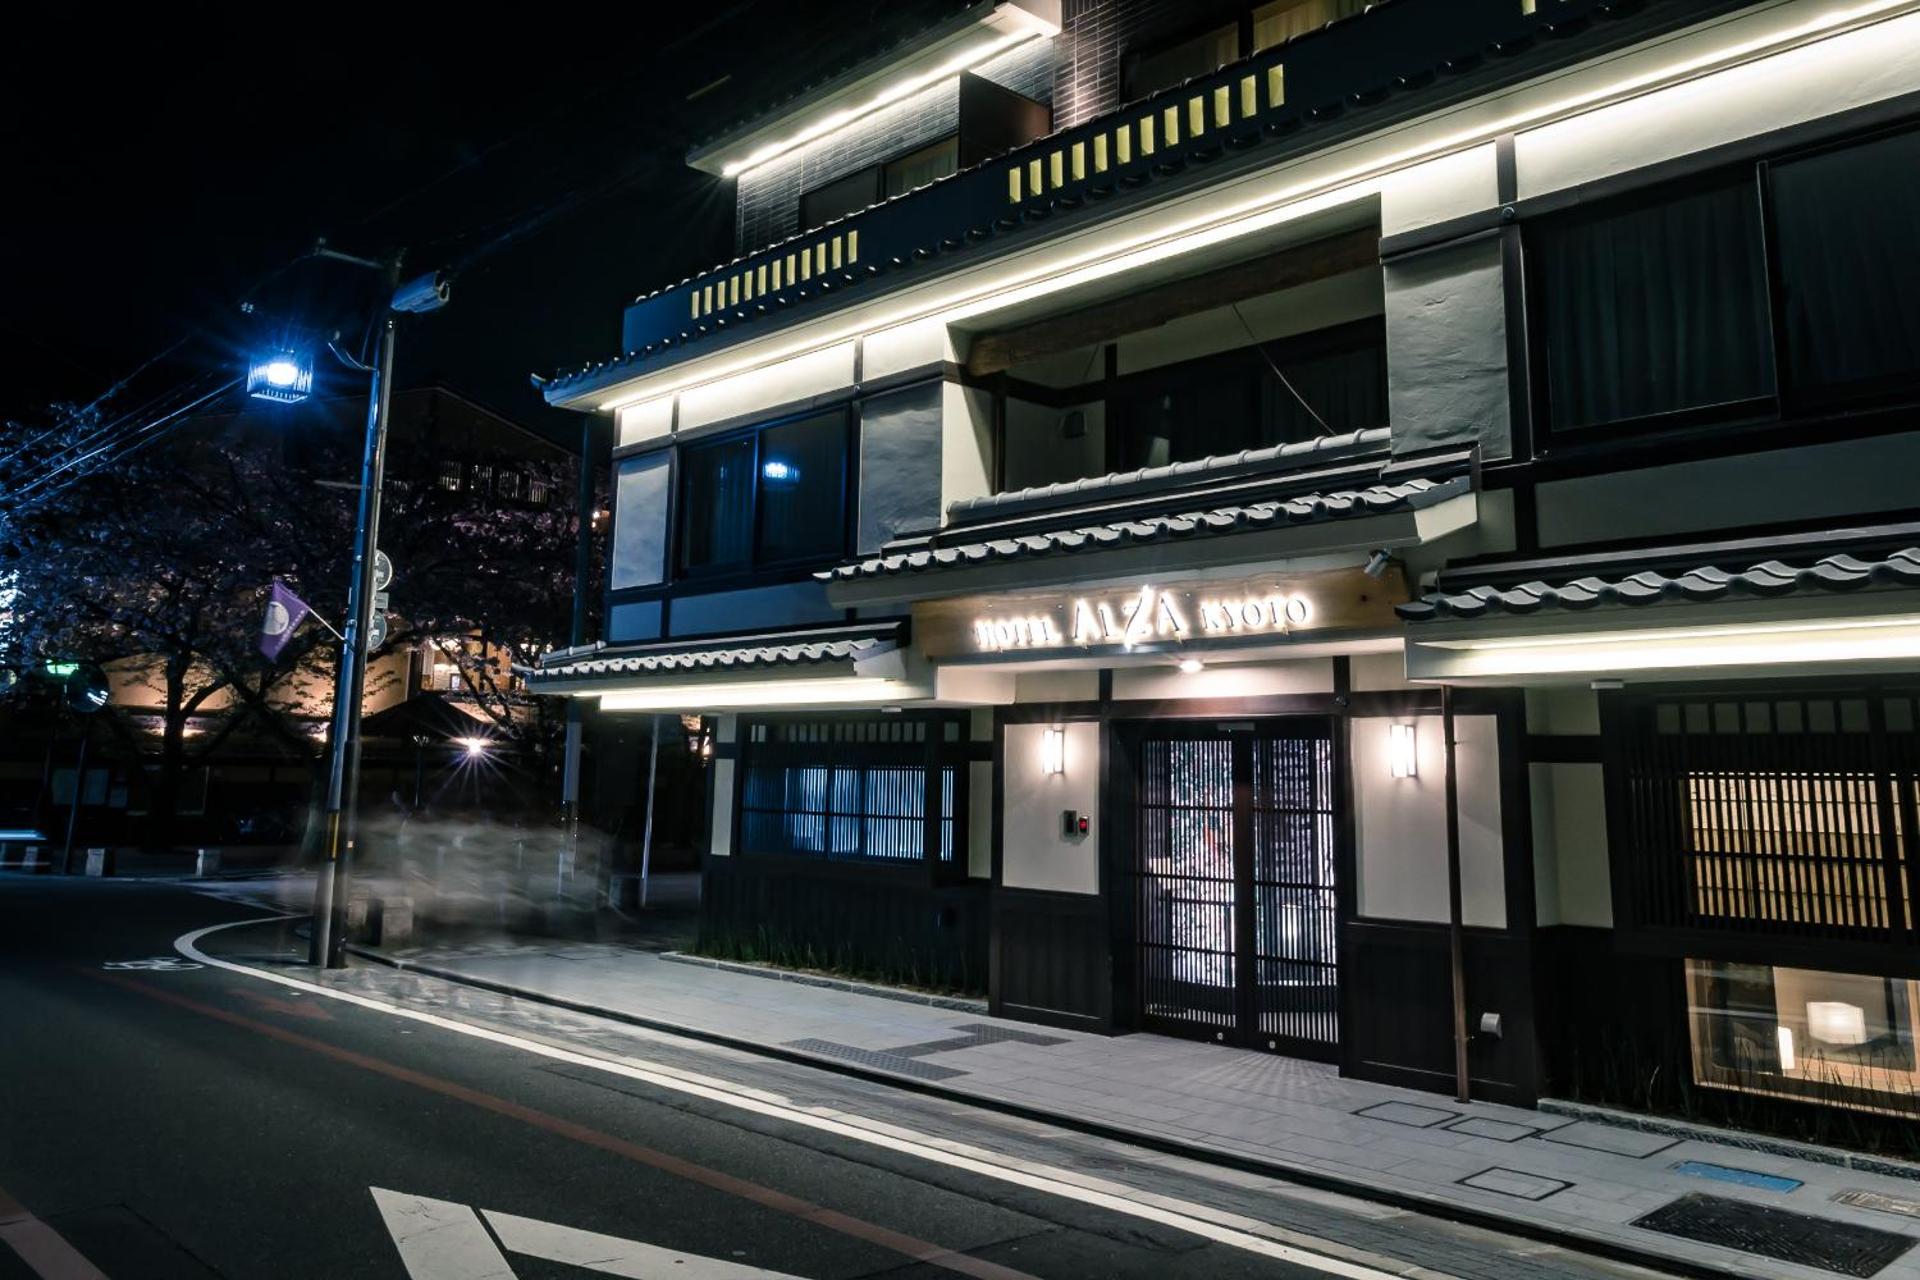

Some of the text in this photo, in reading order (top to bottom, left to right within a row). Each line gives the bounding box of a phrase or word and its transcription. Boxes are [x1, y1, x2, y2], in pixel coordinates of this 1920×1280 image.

[975, 586, 1312, 648] HOTEL ALZA KYOTO
